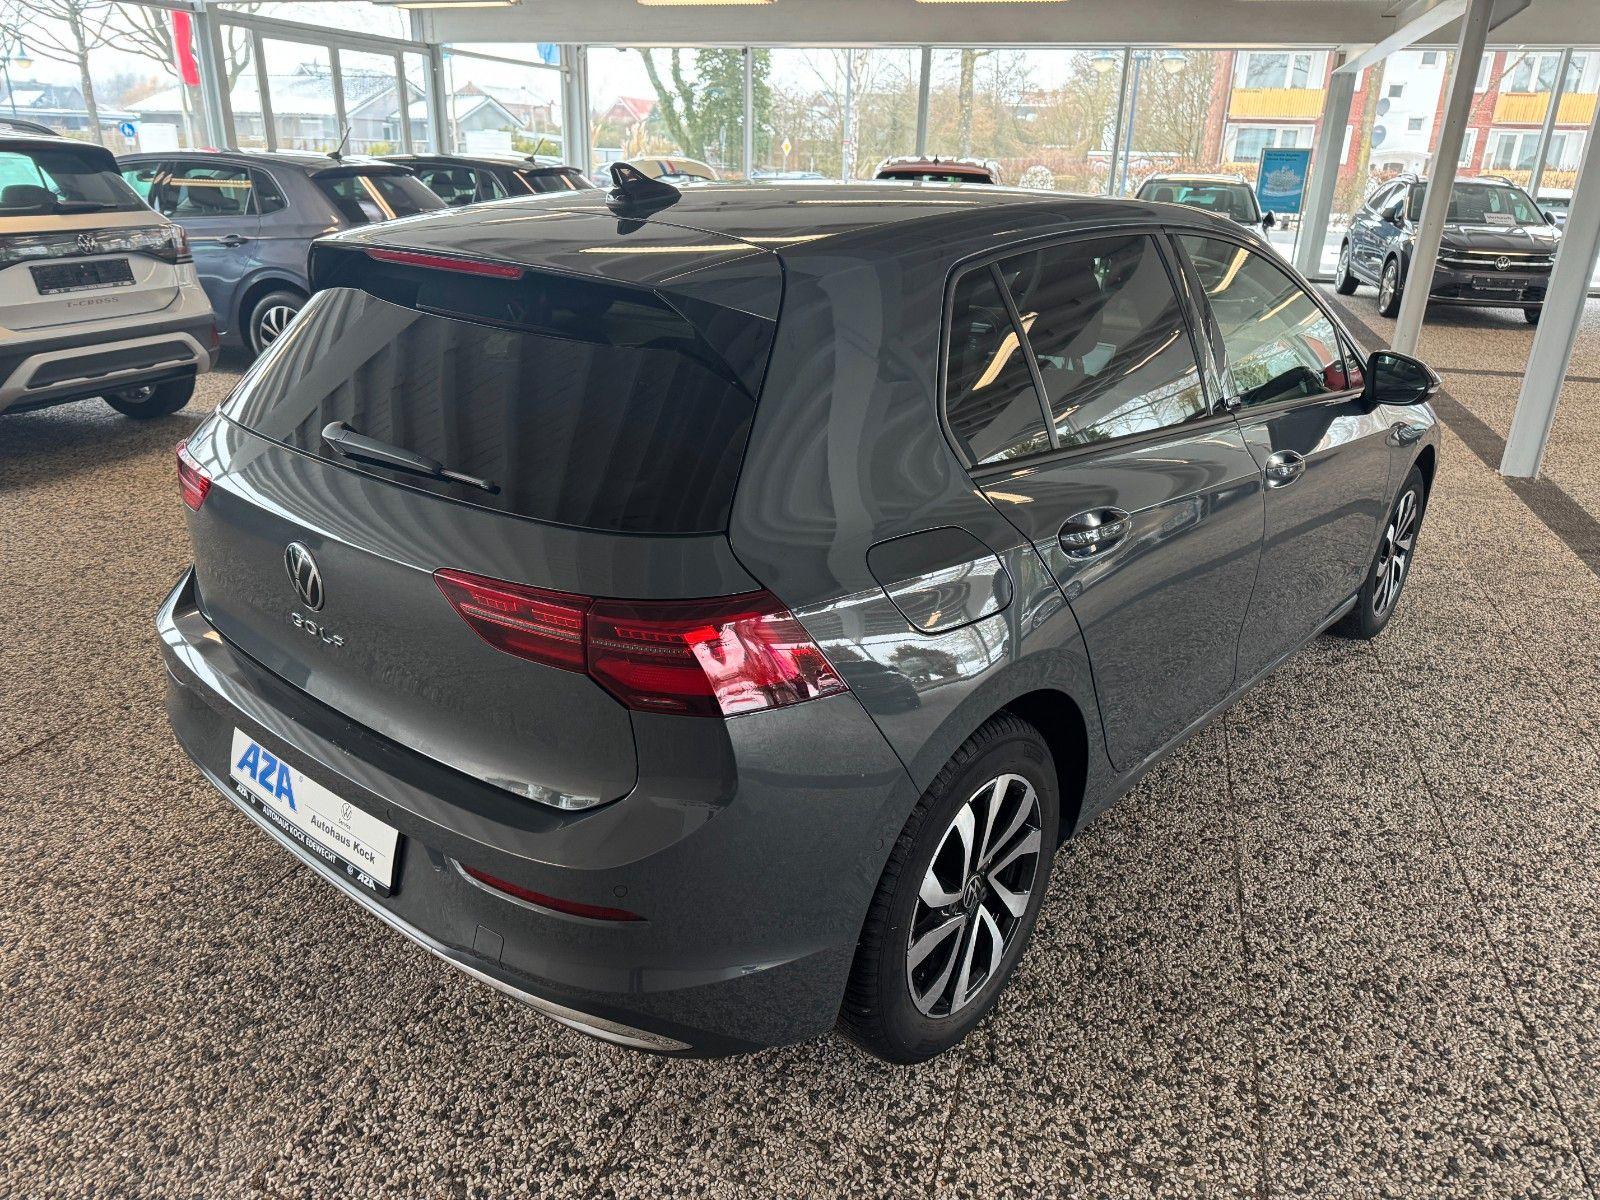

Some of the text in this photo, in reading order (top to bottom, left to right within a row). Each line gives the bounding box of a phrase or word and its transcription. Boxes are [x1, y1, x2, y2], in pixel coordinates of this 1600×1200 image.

[291, 612, 345, 647] GOLF
[236, 742, 298, 814] AZA
[236, 784, 376, 891] AZA AUTOHAUS KOCK EDEWECHT AZA
[310, 815, 376, 865] Autohaus Kock
